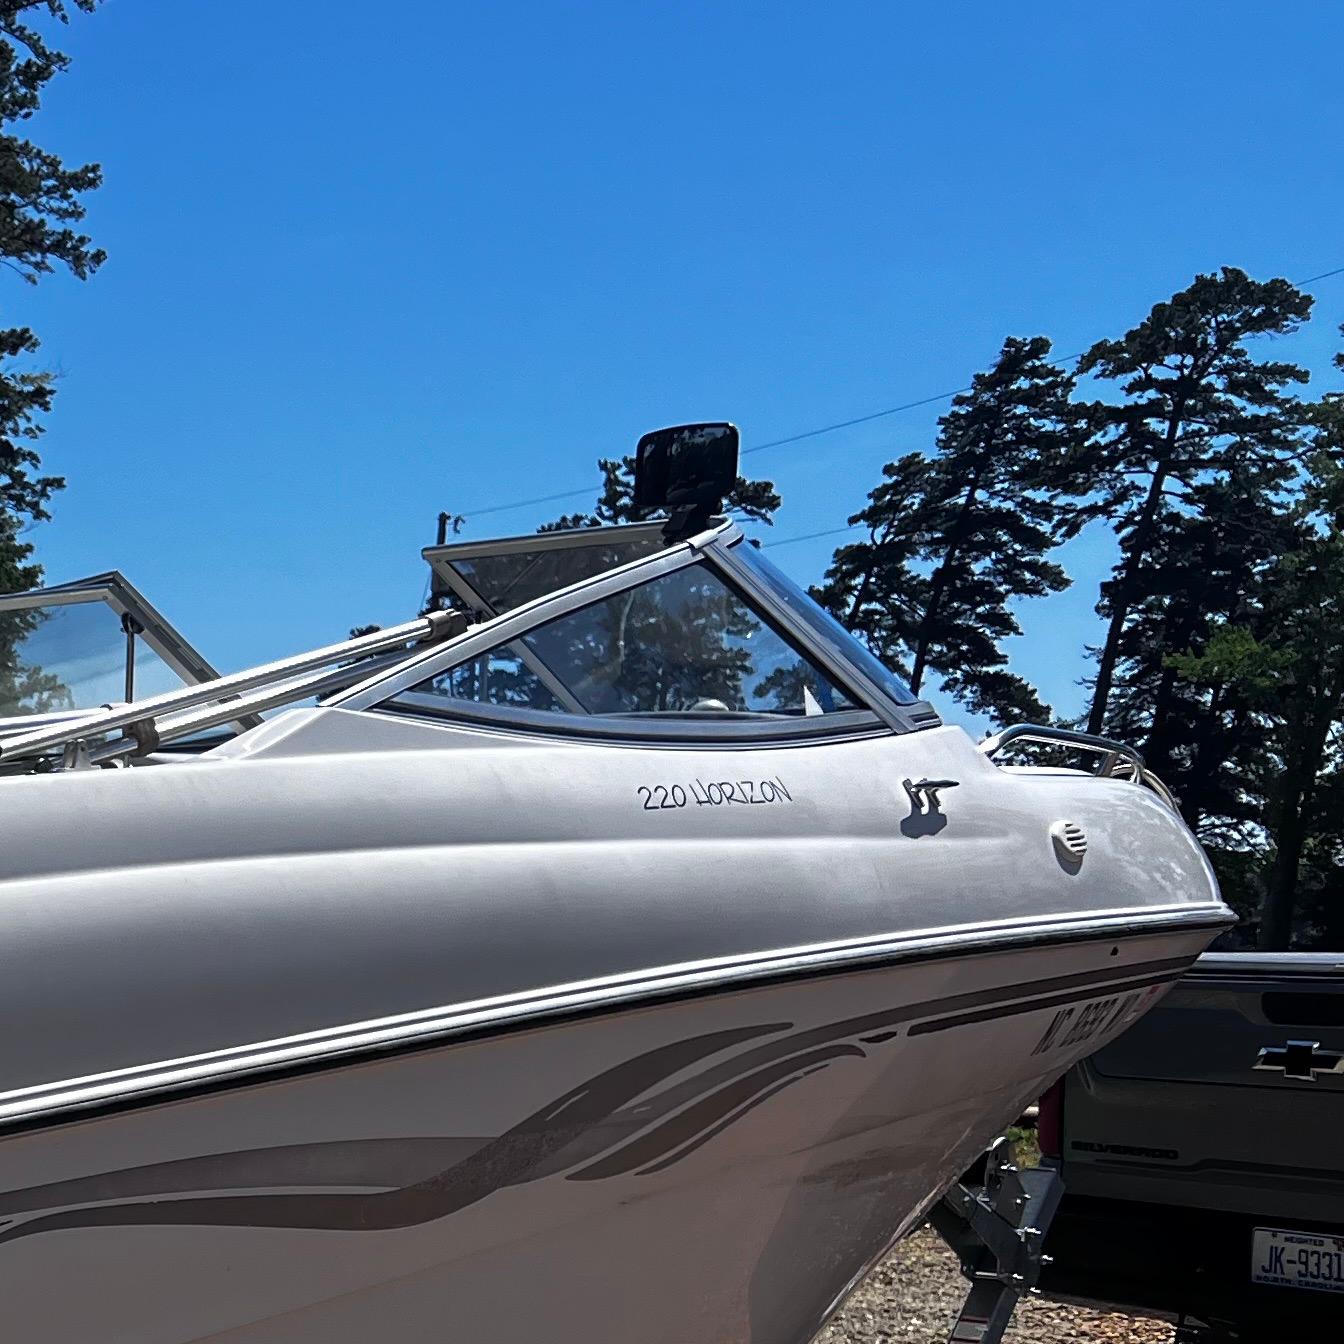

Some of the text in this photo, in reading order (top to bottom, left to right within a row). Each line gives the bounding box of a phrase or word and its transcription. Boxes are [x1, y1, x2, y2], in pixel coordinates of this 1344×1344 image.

[637, 775, 792, 810] 220 HORIZON
[1261, 1245, 1344, 1282] JK-9331
